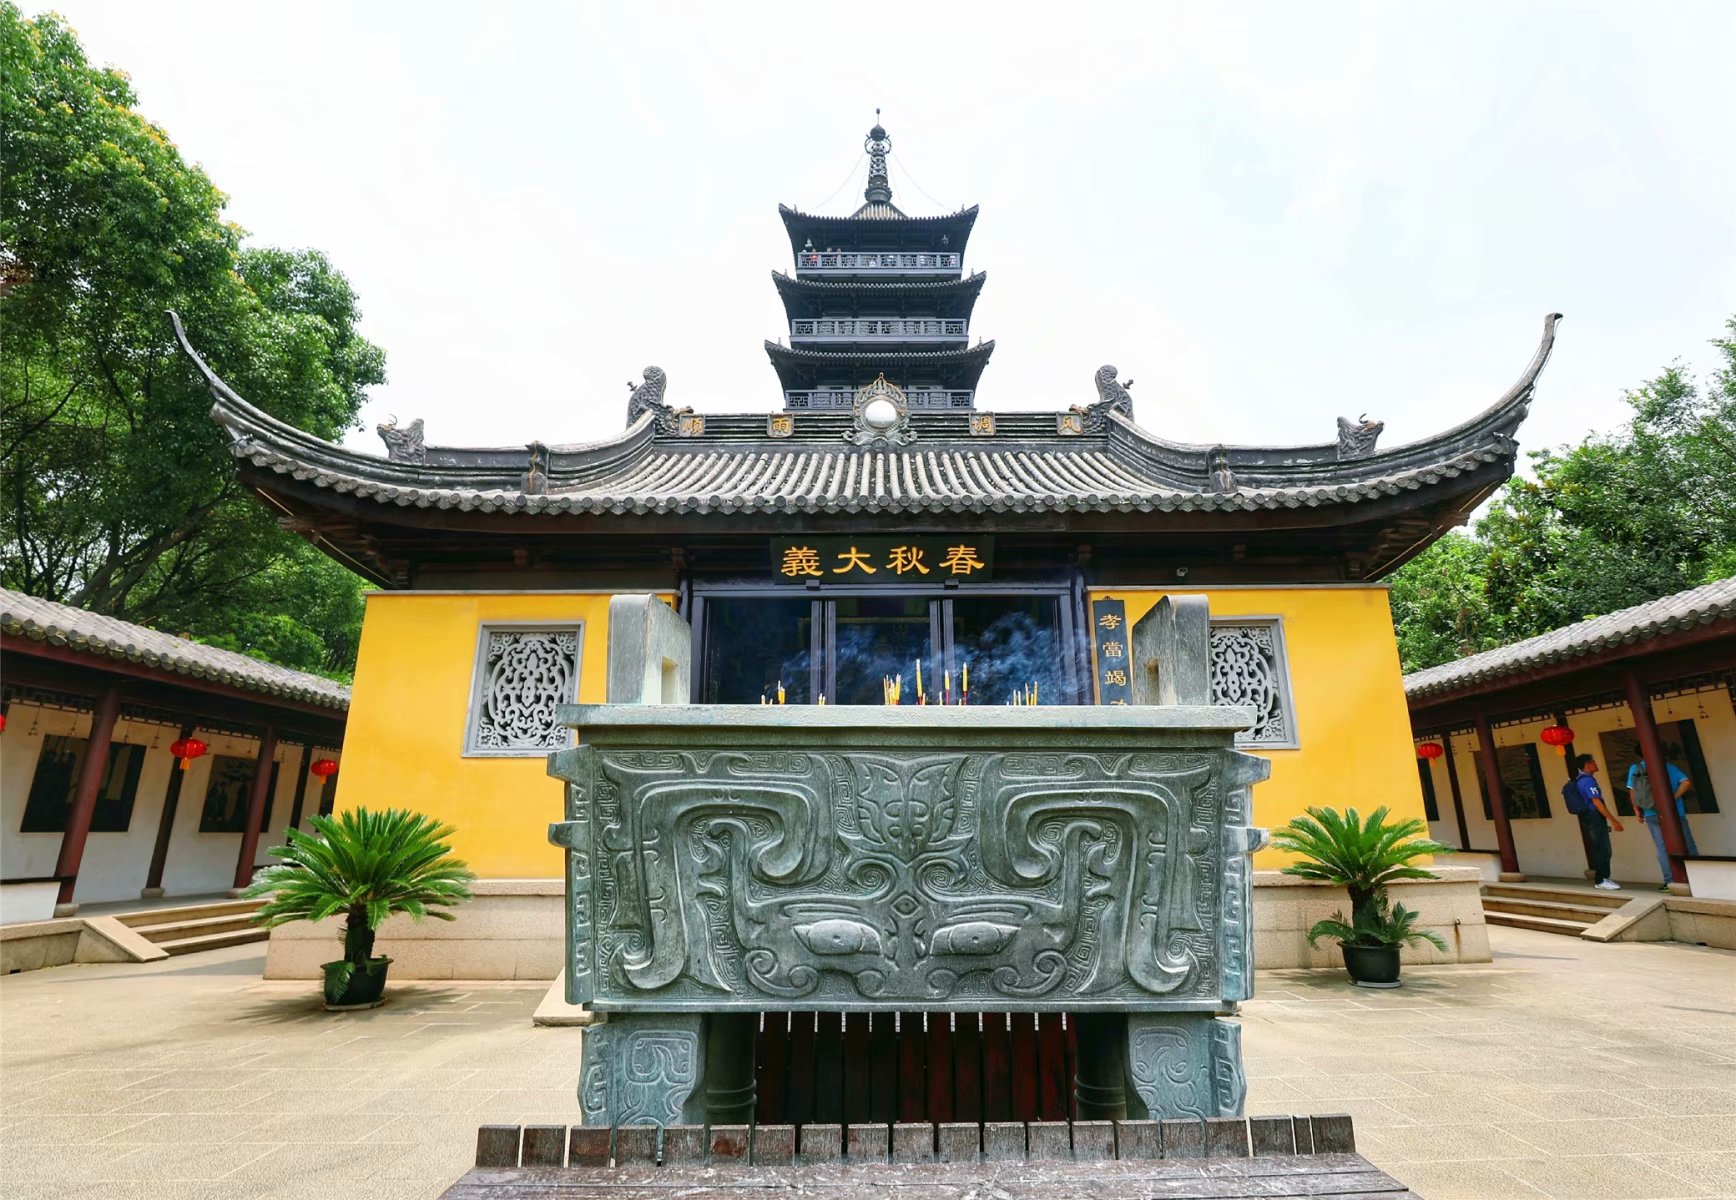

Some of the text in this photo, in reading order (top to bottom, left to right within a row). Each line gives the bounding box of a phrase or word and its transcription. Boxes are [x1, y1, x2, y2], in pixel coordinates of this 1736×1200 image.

[772, 416, 790, 433] 雨
[1099, 614, 1127, 705] 孝當竭
